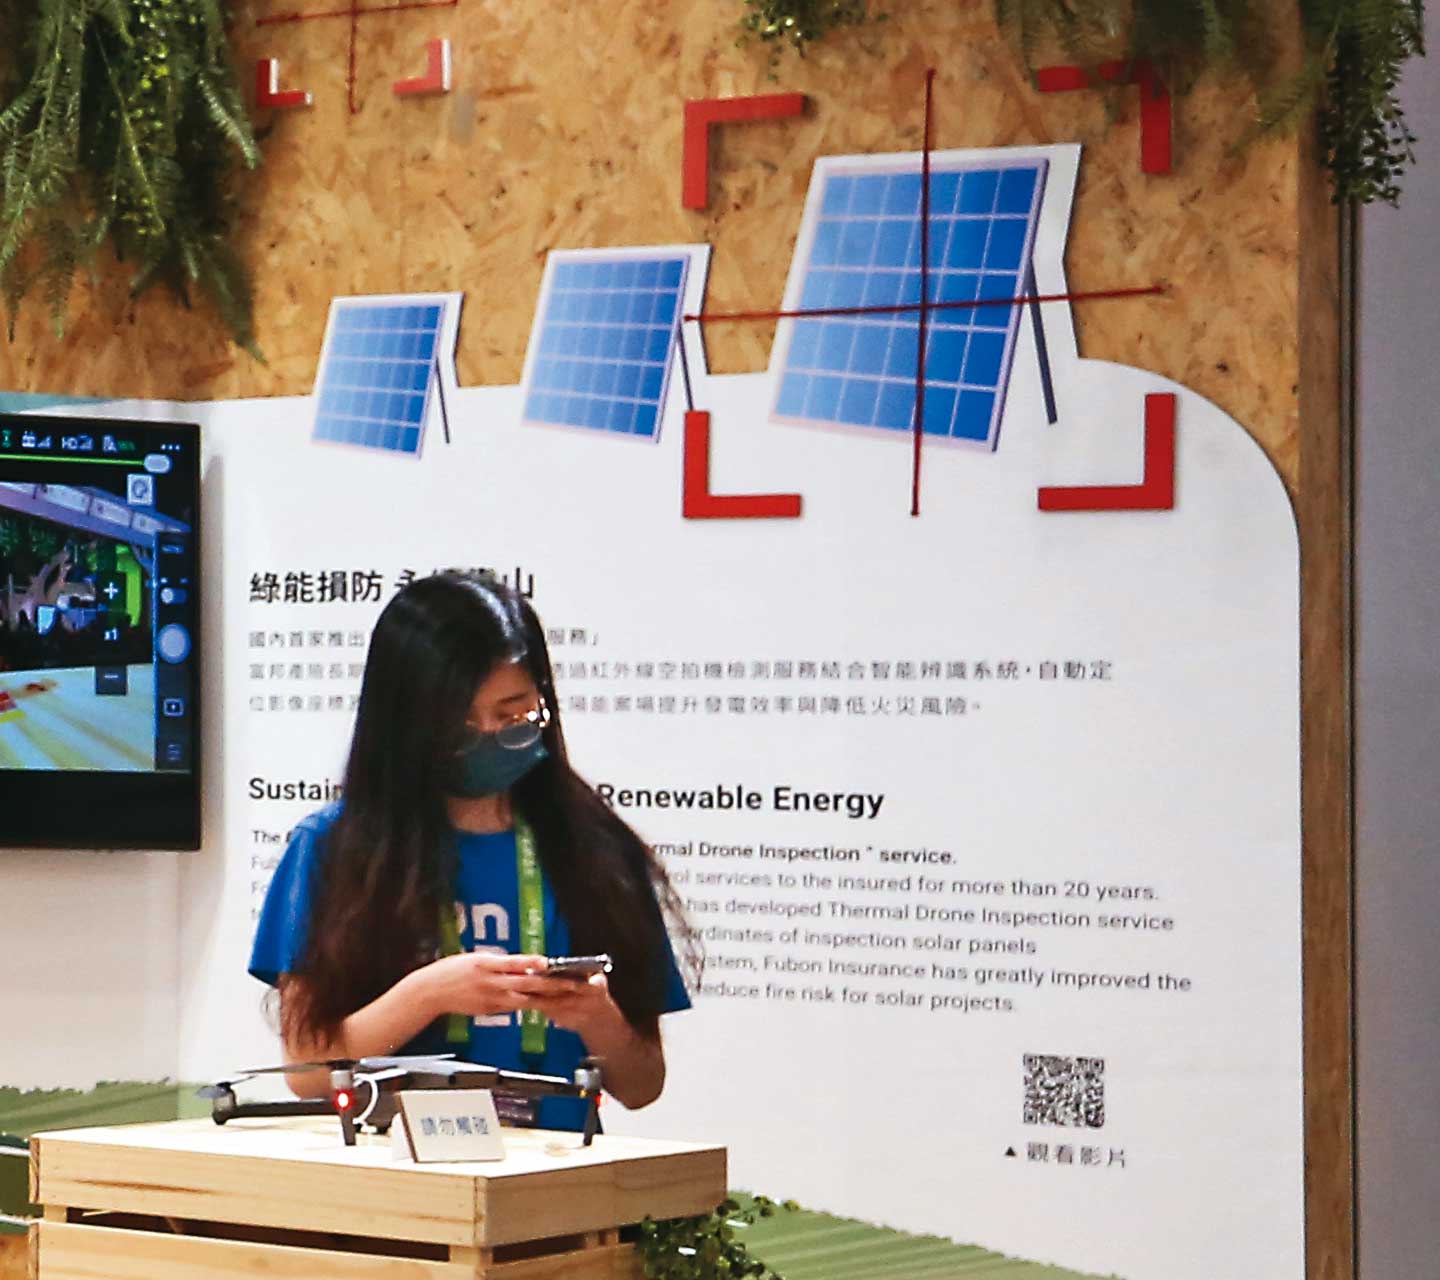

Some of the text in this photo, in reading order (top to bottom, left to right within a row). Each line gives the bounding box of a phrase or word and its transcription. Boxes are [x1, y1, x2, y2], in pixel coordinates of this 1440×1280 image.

[249, 568, 383, 604] 綠能損防
[597, 783, 885, 818] Renewable Energy
[699, 841, 753, 859] Drone
[760, 843, 860, 863] Inspection
[880, 847, 957, 865] service.
[696, 870, 772, 888] services
[778, 873, 796, 889] to
[802, 872, 833, 889] the
[838, 873, 911, 892] insured
[918, 875, 944, 893] for
[952, 880, 1005, 895] more
[1012, 879, 1058, 897] than
[1064, 880, 1090, 898] 20
[1096, 886, 1160, 903] years.
[687, 898, 1175, 931] has developed Thermal Drone Inspection service
[779, 926, 799, 944] of
[805, 928, 907, 951] inspection
[913, 934, 962, 951] solar
[968, 937, 1037, 955] panels
[764, 955, 822, 973] Fubon
[829, 957, 926, 978] Insurance
[932, 962, 968, 980] has
[974, 965, 1044, 988] greatly
[1051, 969, 1150, 991] improved
[1157, 972, 1192, 992] the
[765, 984, 796, 1001] fire
[801, 986, 834, 1002] risk
[841, 987, 869, 1003] for
[875, 989, 923, 1007] solar
